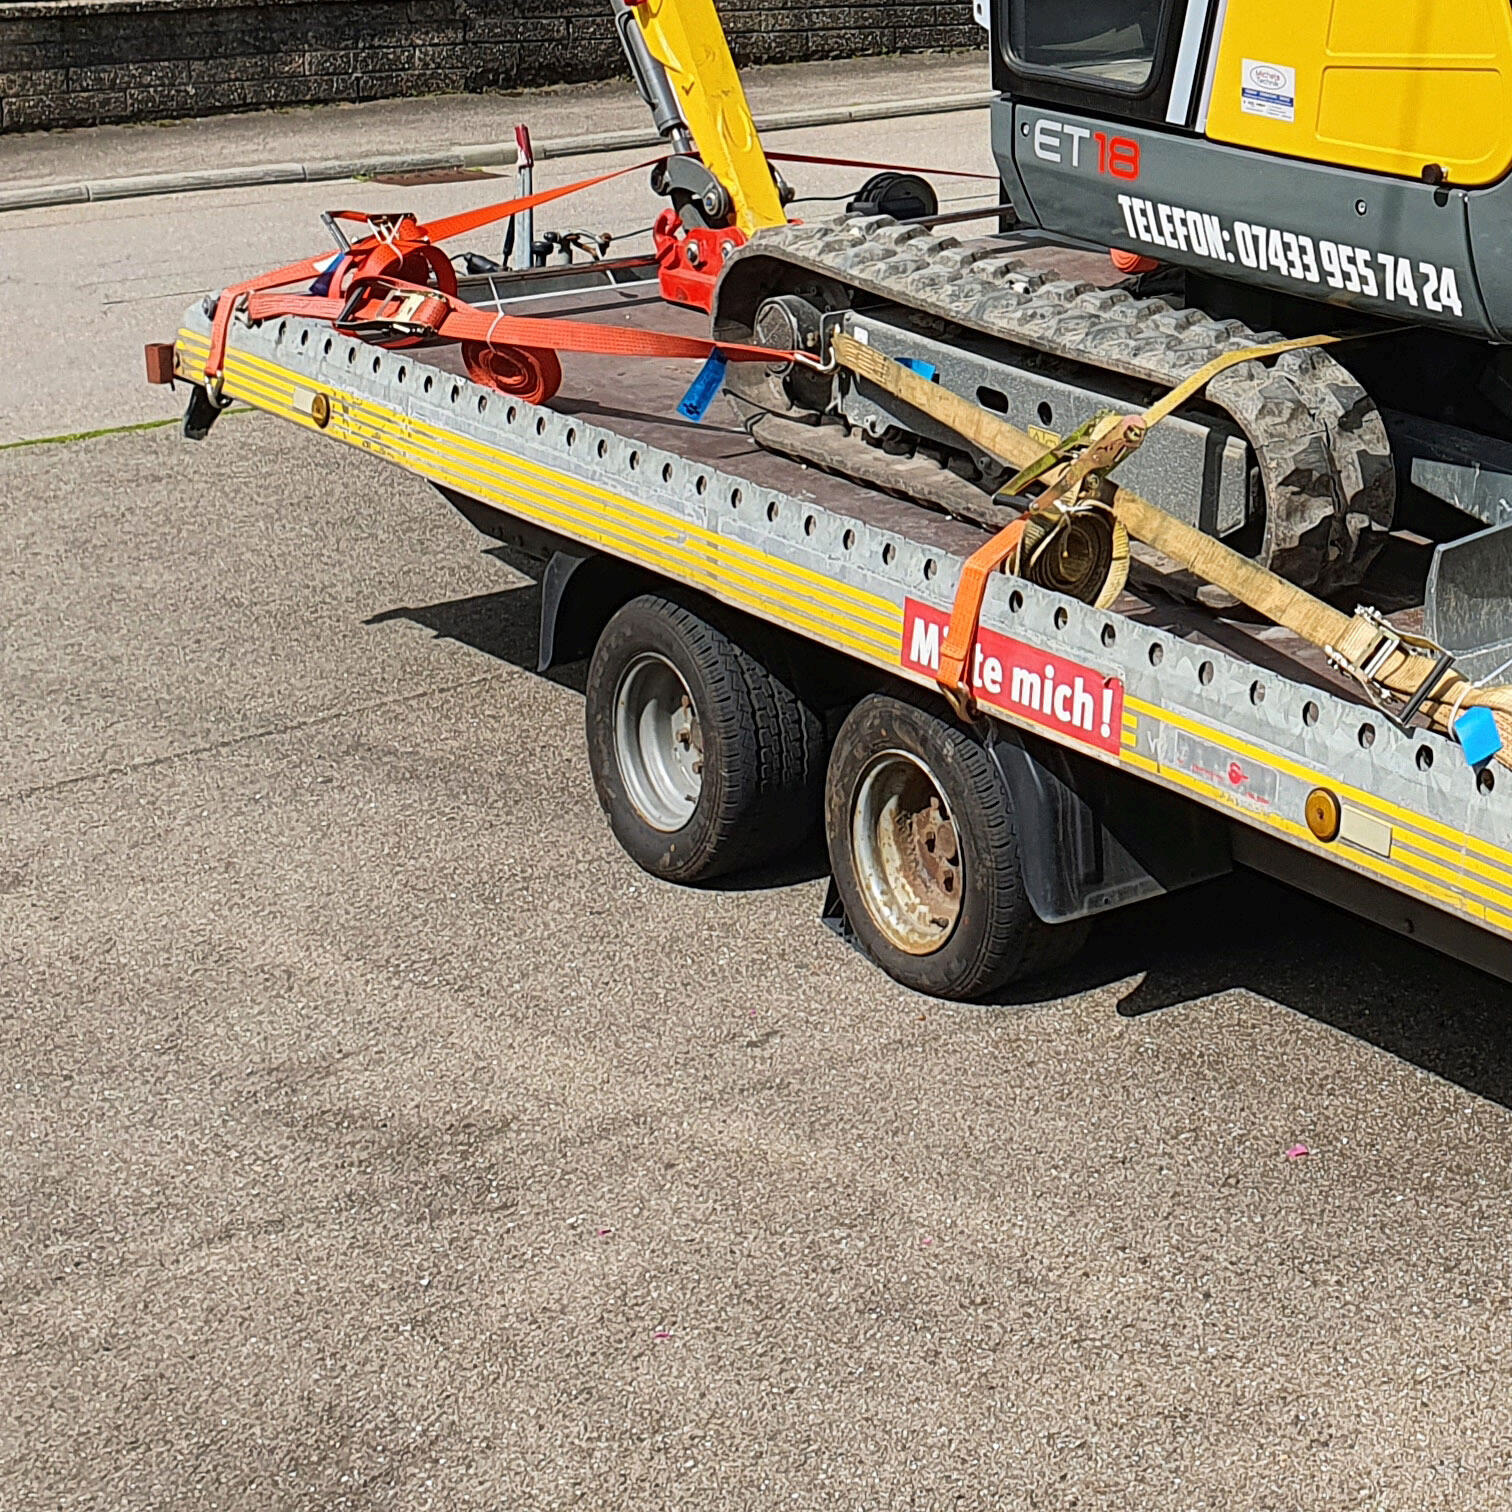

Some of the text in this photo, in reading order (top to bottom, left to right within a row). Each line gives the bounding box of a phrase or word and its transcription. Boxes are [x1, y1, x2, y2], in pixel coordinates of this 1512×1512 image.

[1118, 194, 1463, 317] TELEFON: 07433 955 74 24
[910, 617, 1003, 694] Mte
